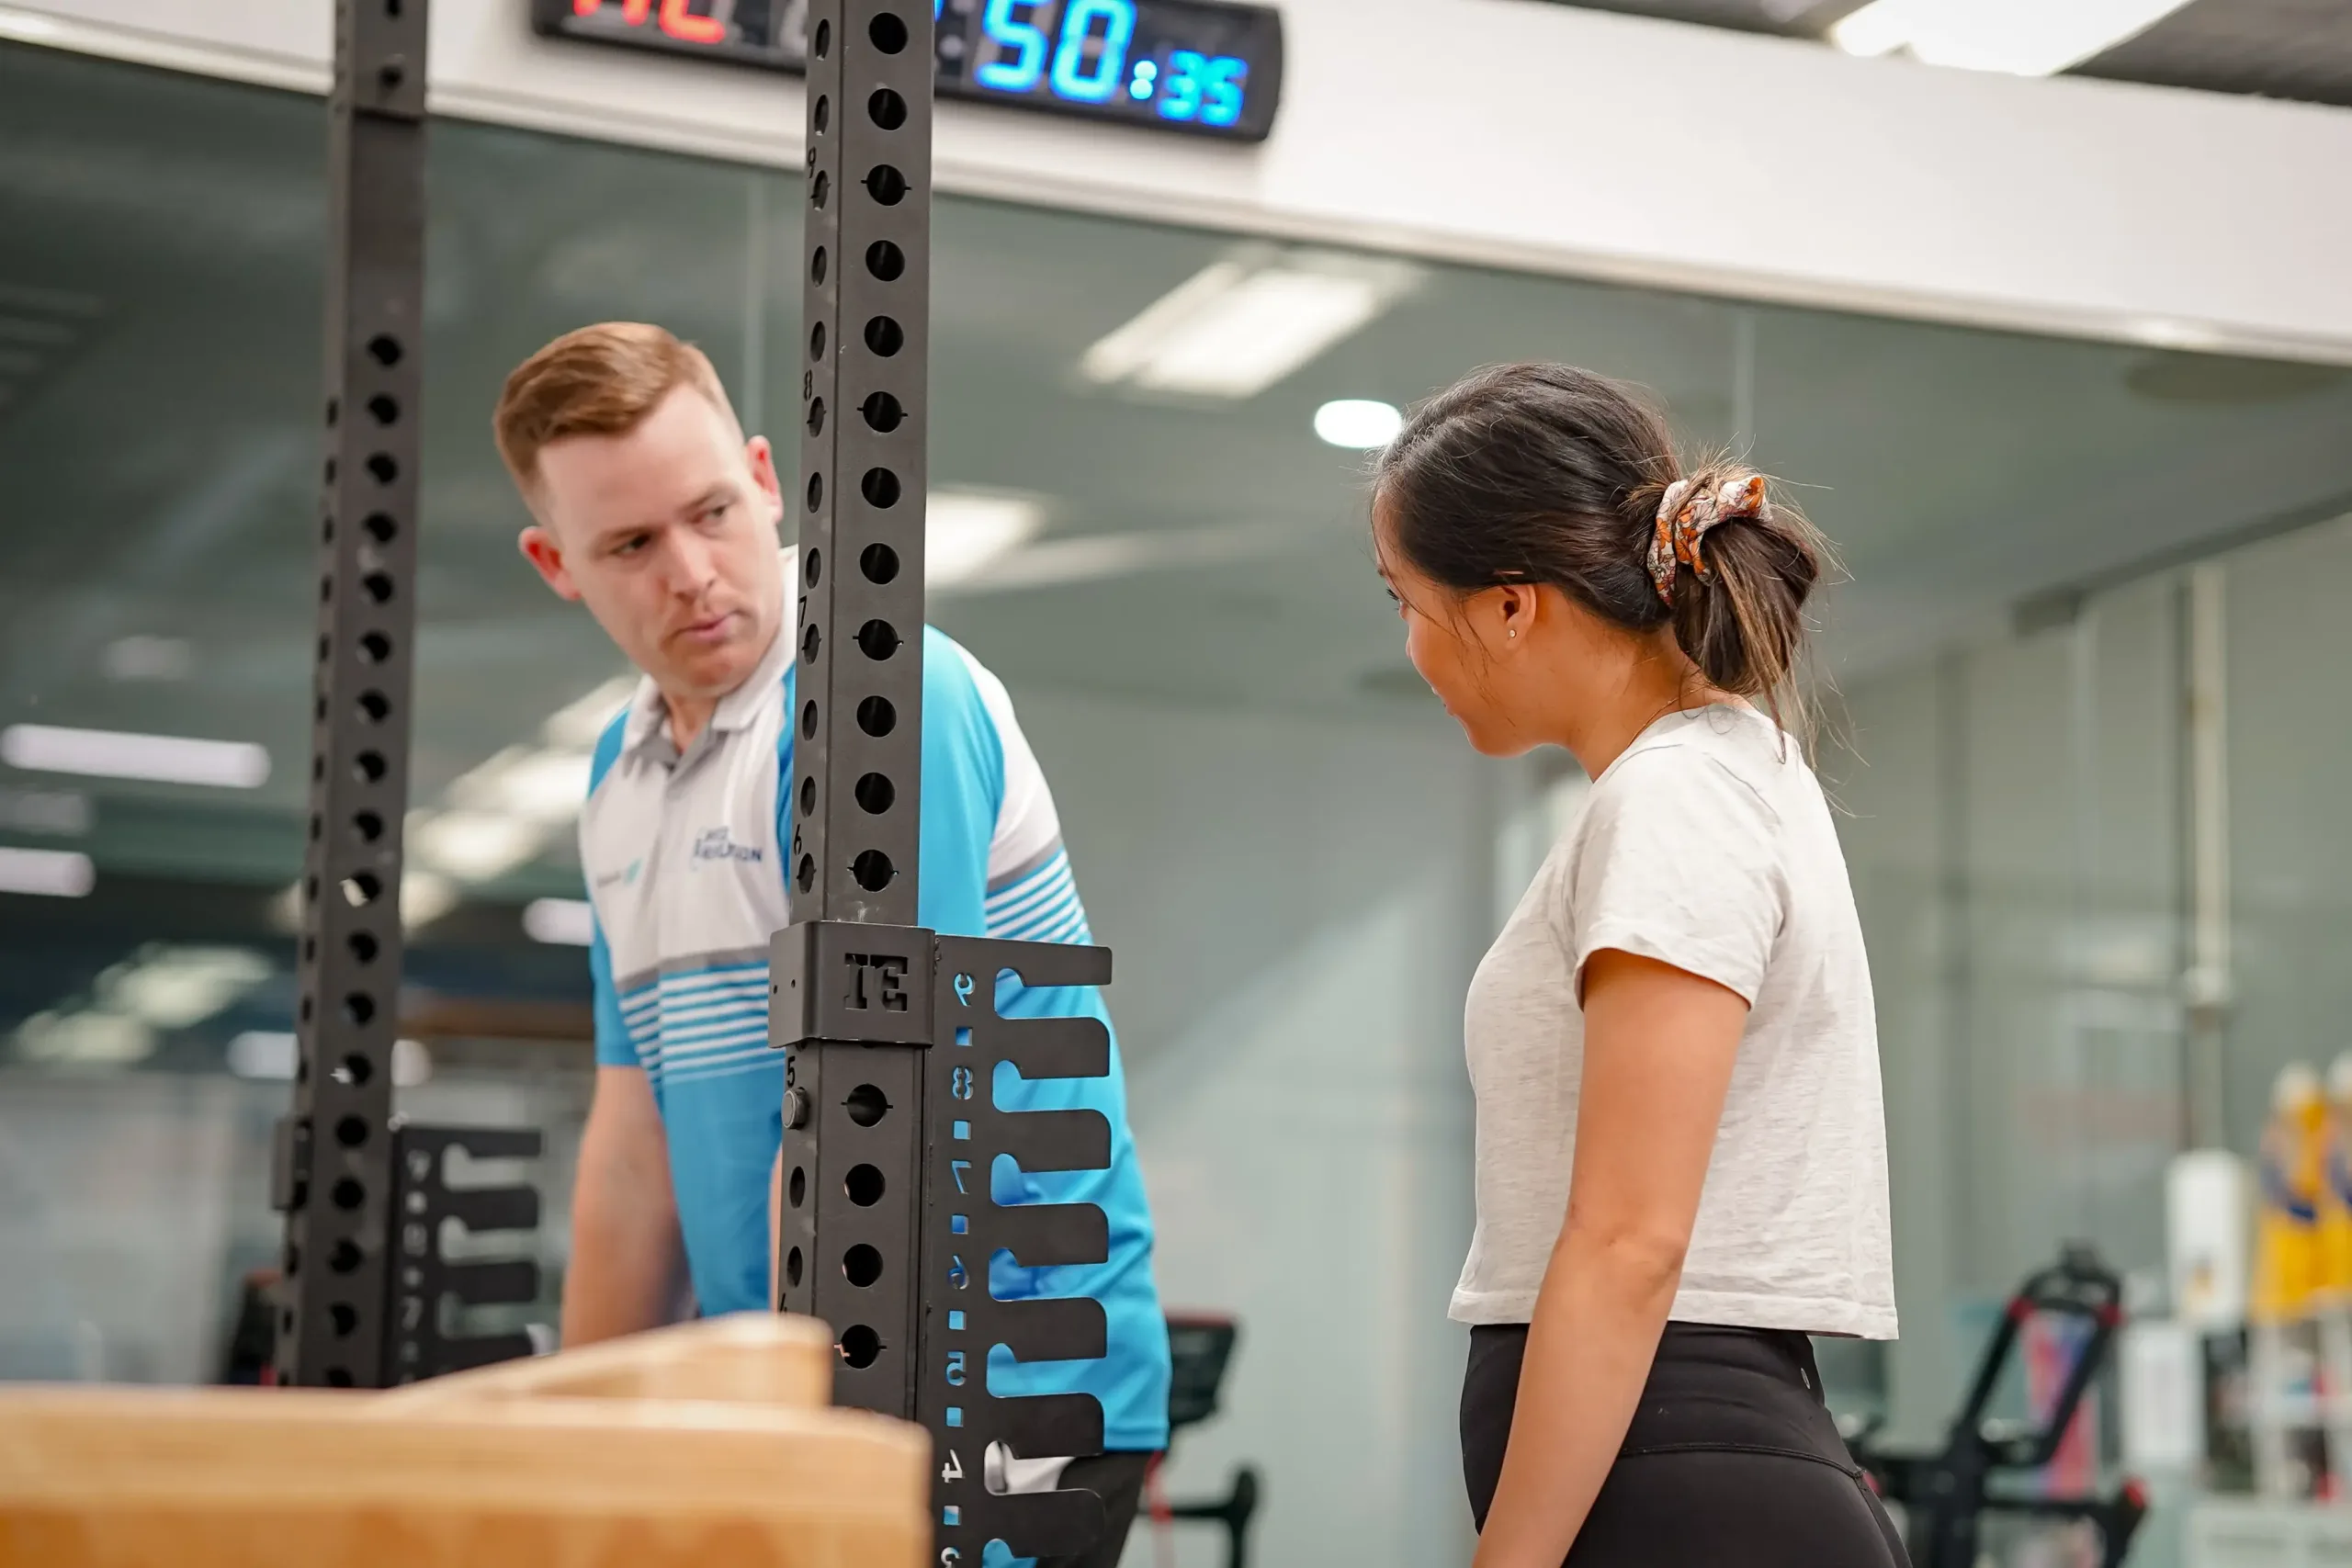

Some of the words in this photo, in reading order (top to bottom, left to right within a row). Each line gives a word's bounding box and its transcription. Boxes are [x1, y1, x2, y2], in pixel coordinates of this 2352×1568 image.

[808, 146, 817, 179] 9
[804, 369, 812, 401] 8
[799, 595, 807, 628] 7
[794, 823, 802, 856] 6
[787, 1055, 796, 1089] 5
